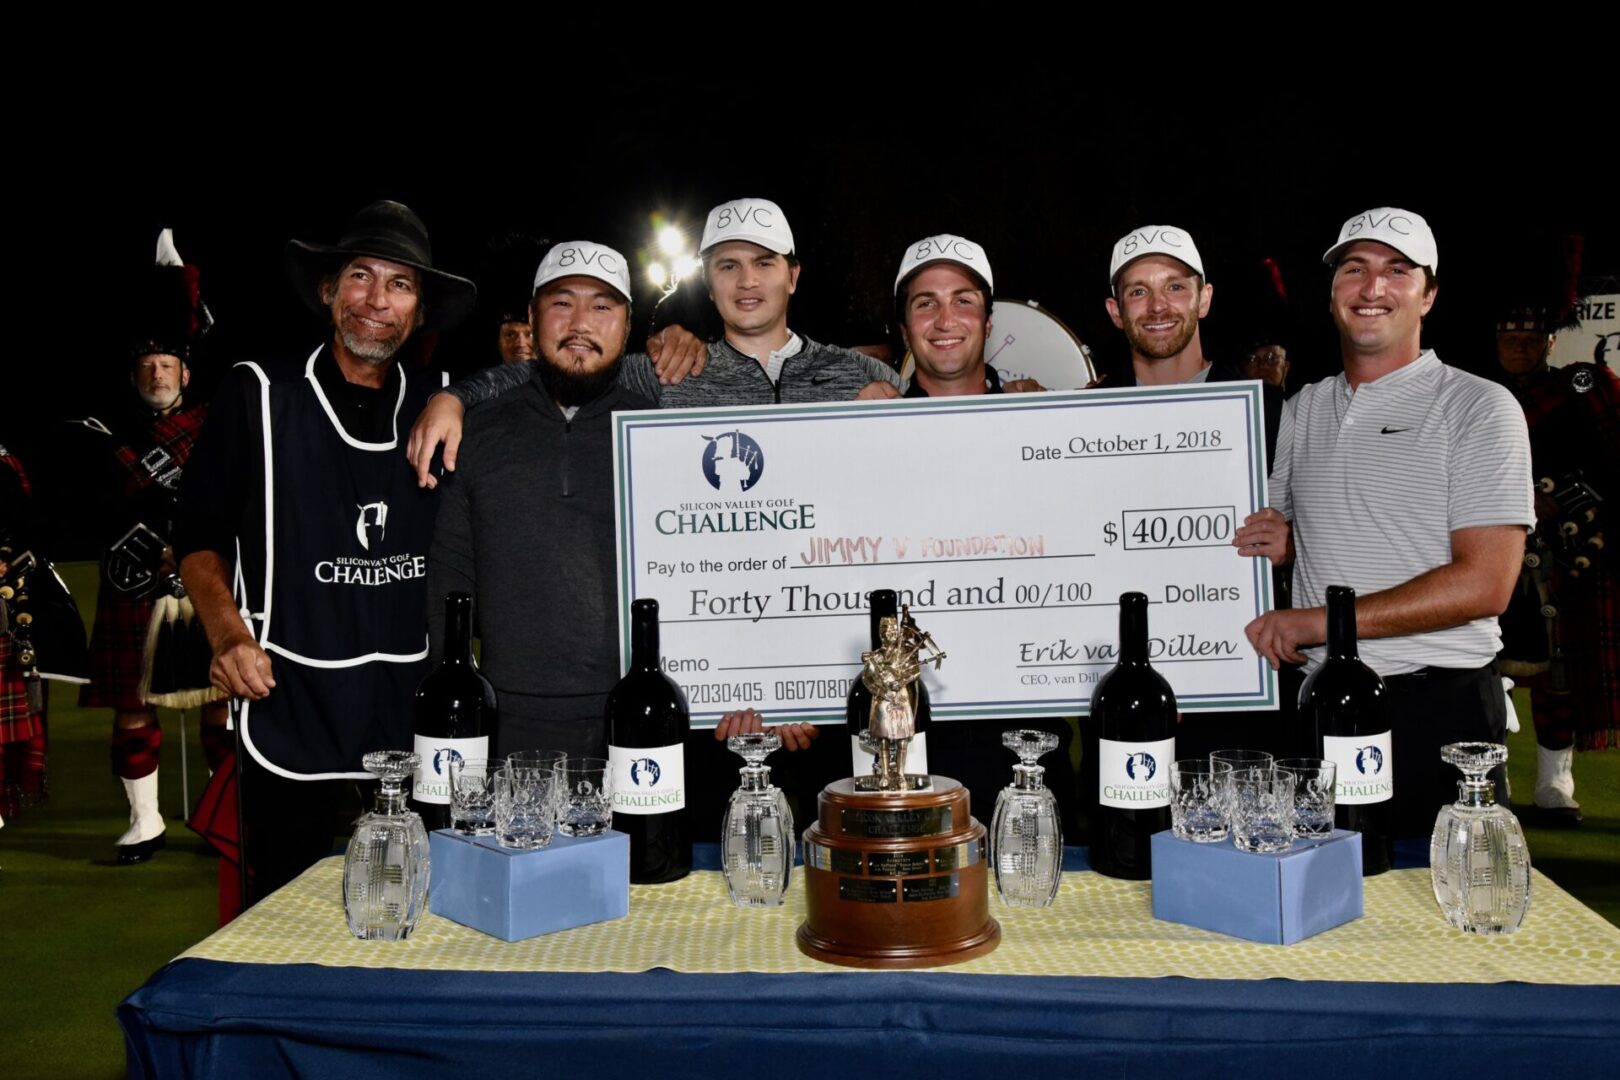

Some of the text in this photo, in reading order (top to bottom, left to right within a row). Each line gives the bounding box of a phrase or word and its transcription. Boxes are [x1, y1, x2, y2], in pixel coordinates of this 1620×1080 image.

[717, 206, 772, 229] 8VC
[1348, 213, 1412, 237] 8VC
[915, 239, 974, 260] 8VC
[1123, 230, 1182, 255] 8VC
[558, 247, 617, 274] 8VC
[1575, 302, 1616, 320] RIZE
[1021, 429, 1222, 461] Date October 1, 2018
[680, 498, 795, 511] SILICON VALLEY GOLF
[655, 504, 816, 536] CHALLENGE
[1103, 513, 1231, 547] $ 40,000
[336, 556, 370, 567] SILICON
[389, 553, 410, 564] GOLF
[800, 535, 883, 566] JIMMY
[921, 533, 1046, 559] FOUNDATION
[647, 556, 787, 577] Pay to the order of
[688, 577, 1093, 623] Forty Thousnd and 00/100
[1165, 584, 1241, 604] Dollars
[1018, 634, 1238, 662] Erik va Dillen
[1020, 673, 1101, 686] CEO, van Dill
[415, 780, 450, 797] CHALL
[612, 789, 682, 807] CHALLENGE
[1103, 785, 1168, 801] CHALLENG
[1335, 781, 1392, 797] CHALLENG
